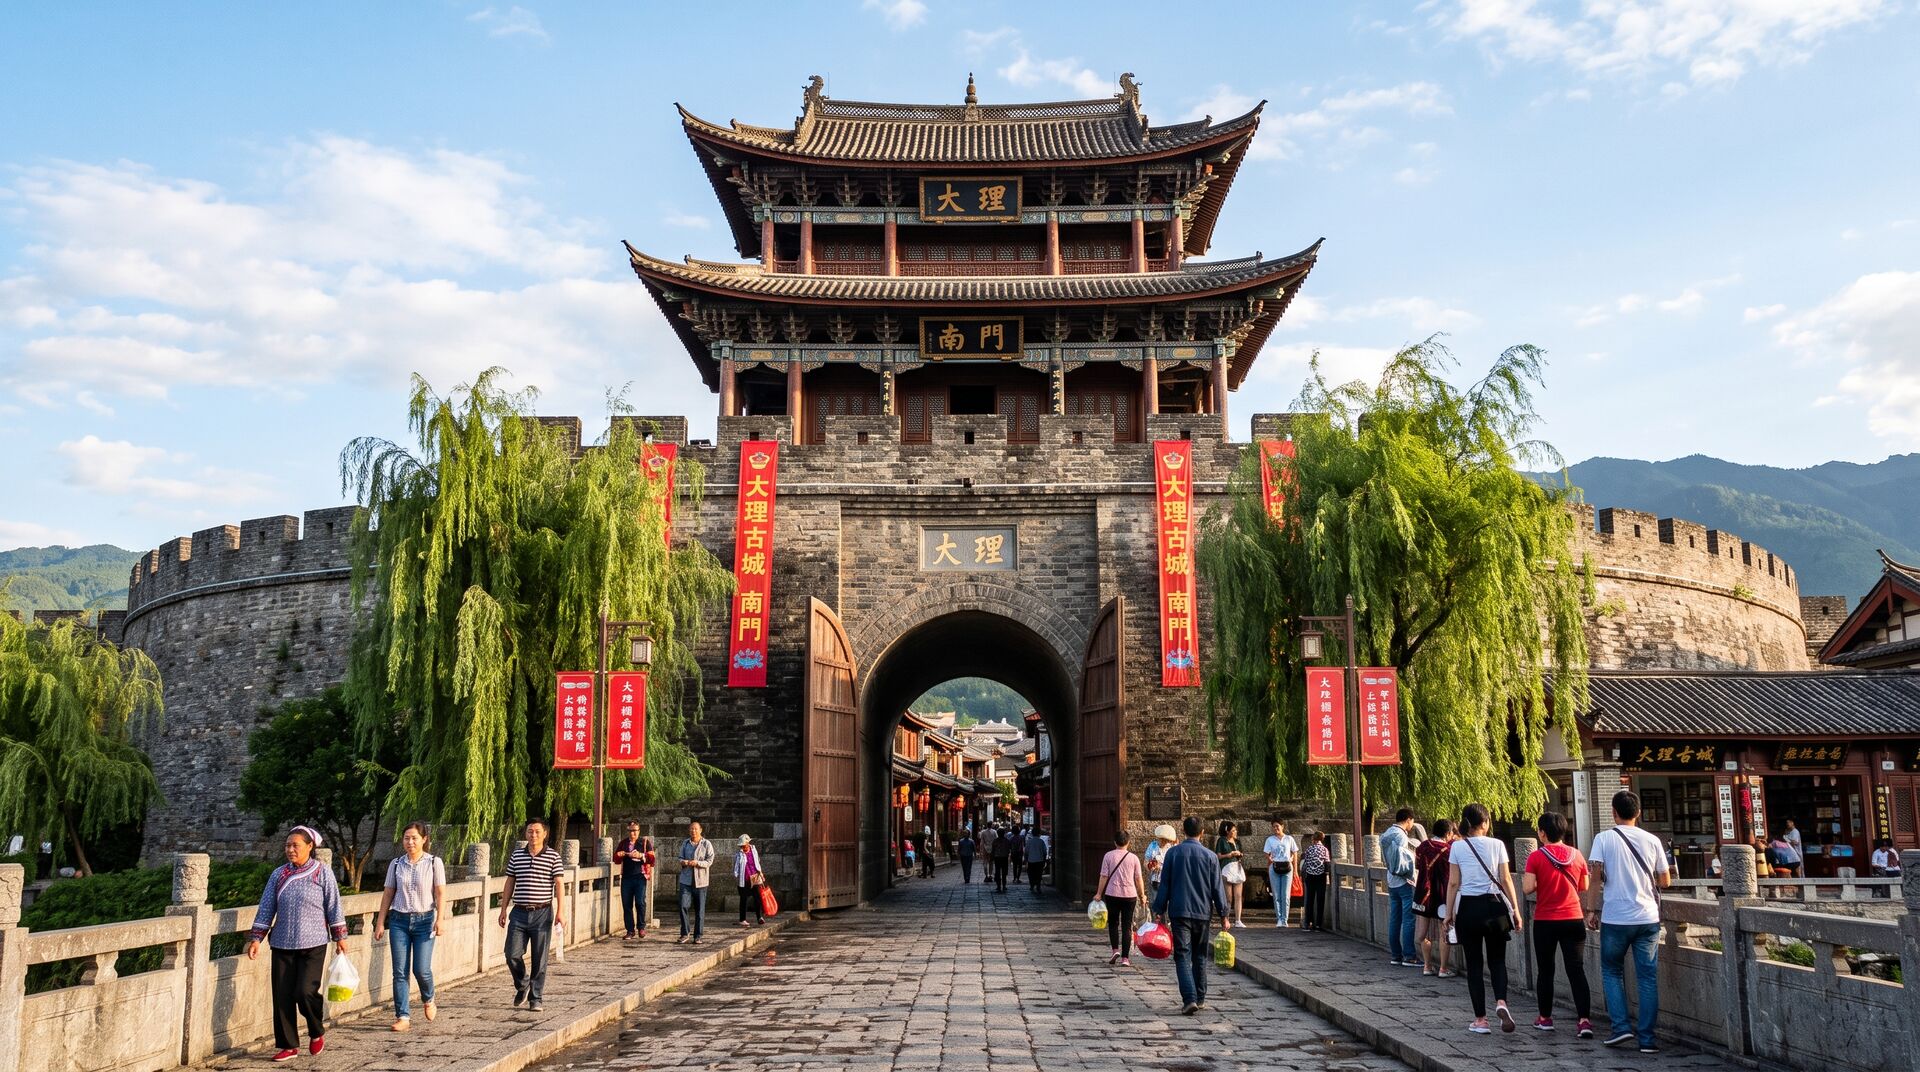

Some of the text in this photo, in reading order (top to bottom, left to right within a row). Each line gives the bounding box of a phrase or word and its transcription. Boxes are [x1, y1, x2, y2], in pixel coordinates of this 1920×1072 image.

[937, 183, 1006, 212] 大理
[939, 323, 1004, 352] 南門
[738, 475, 769, 641] 大理古城 南門
[933, 532, 1005, 565] 大理
[1164, 475, 1191, 642] 大理古城 南門
[1636, 746, 1714, 763] 大理古城
